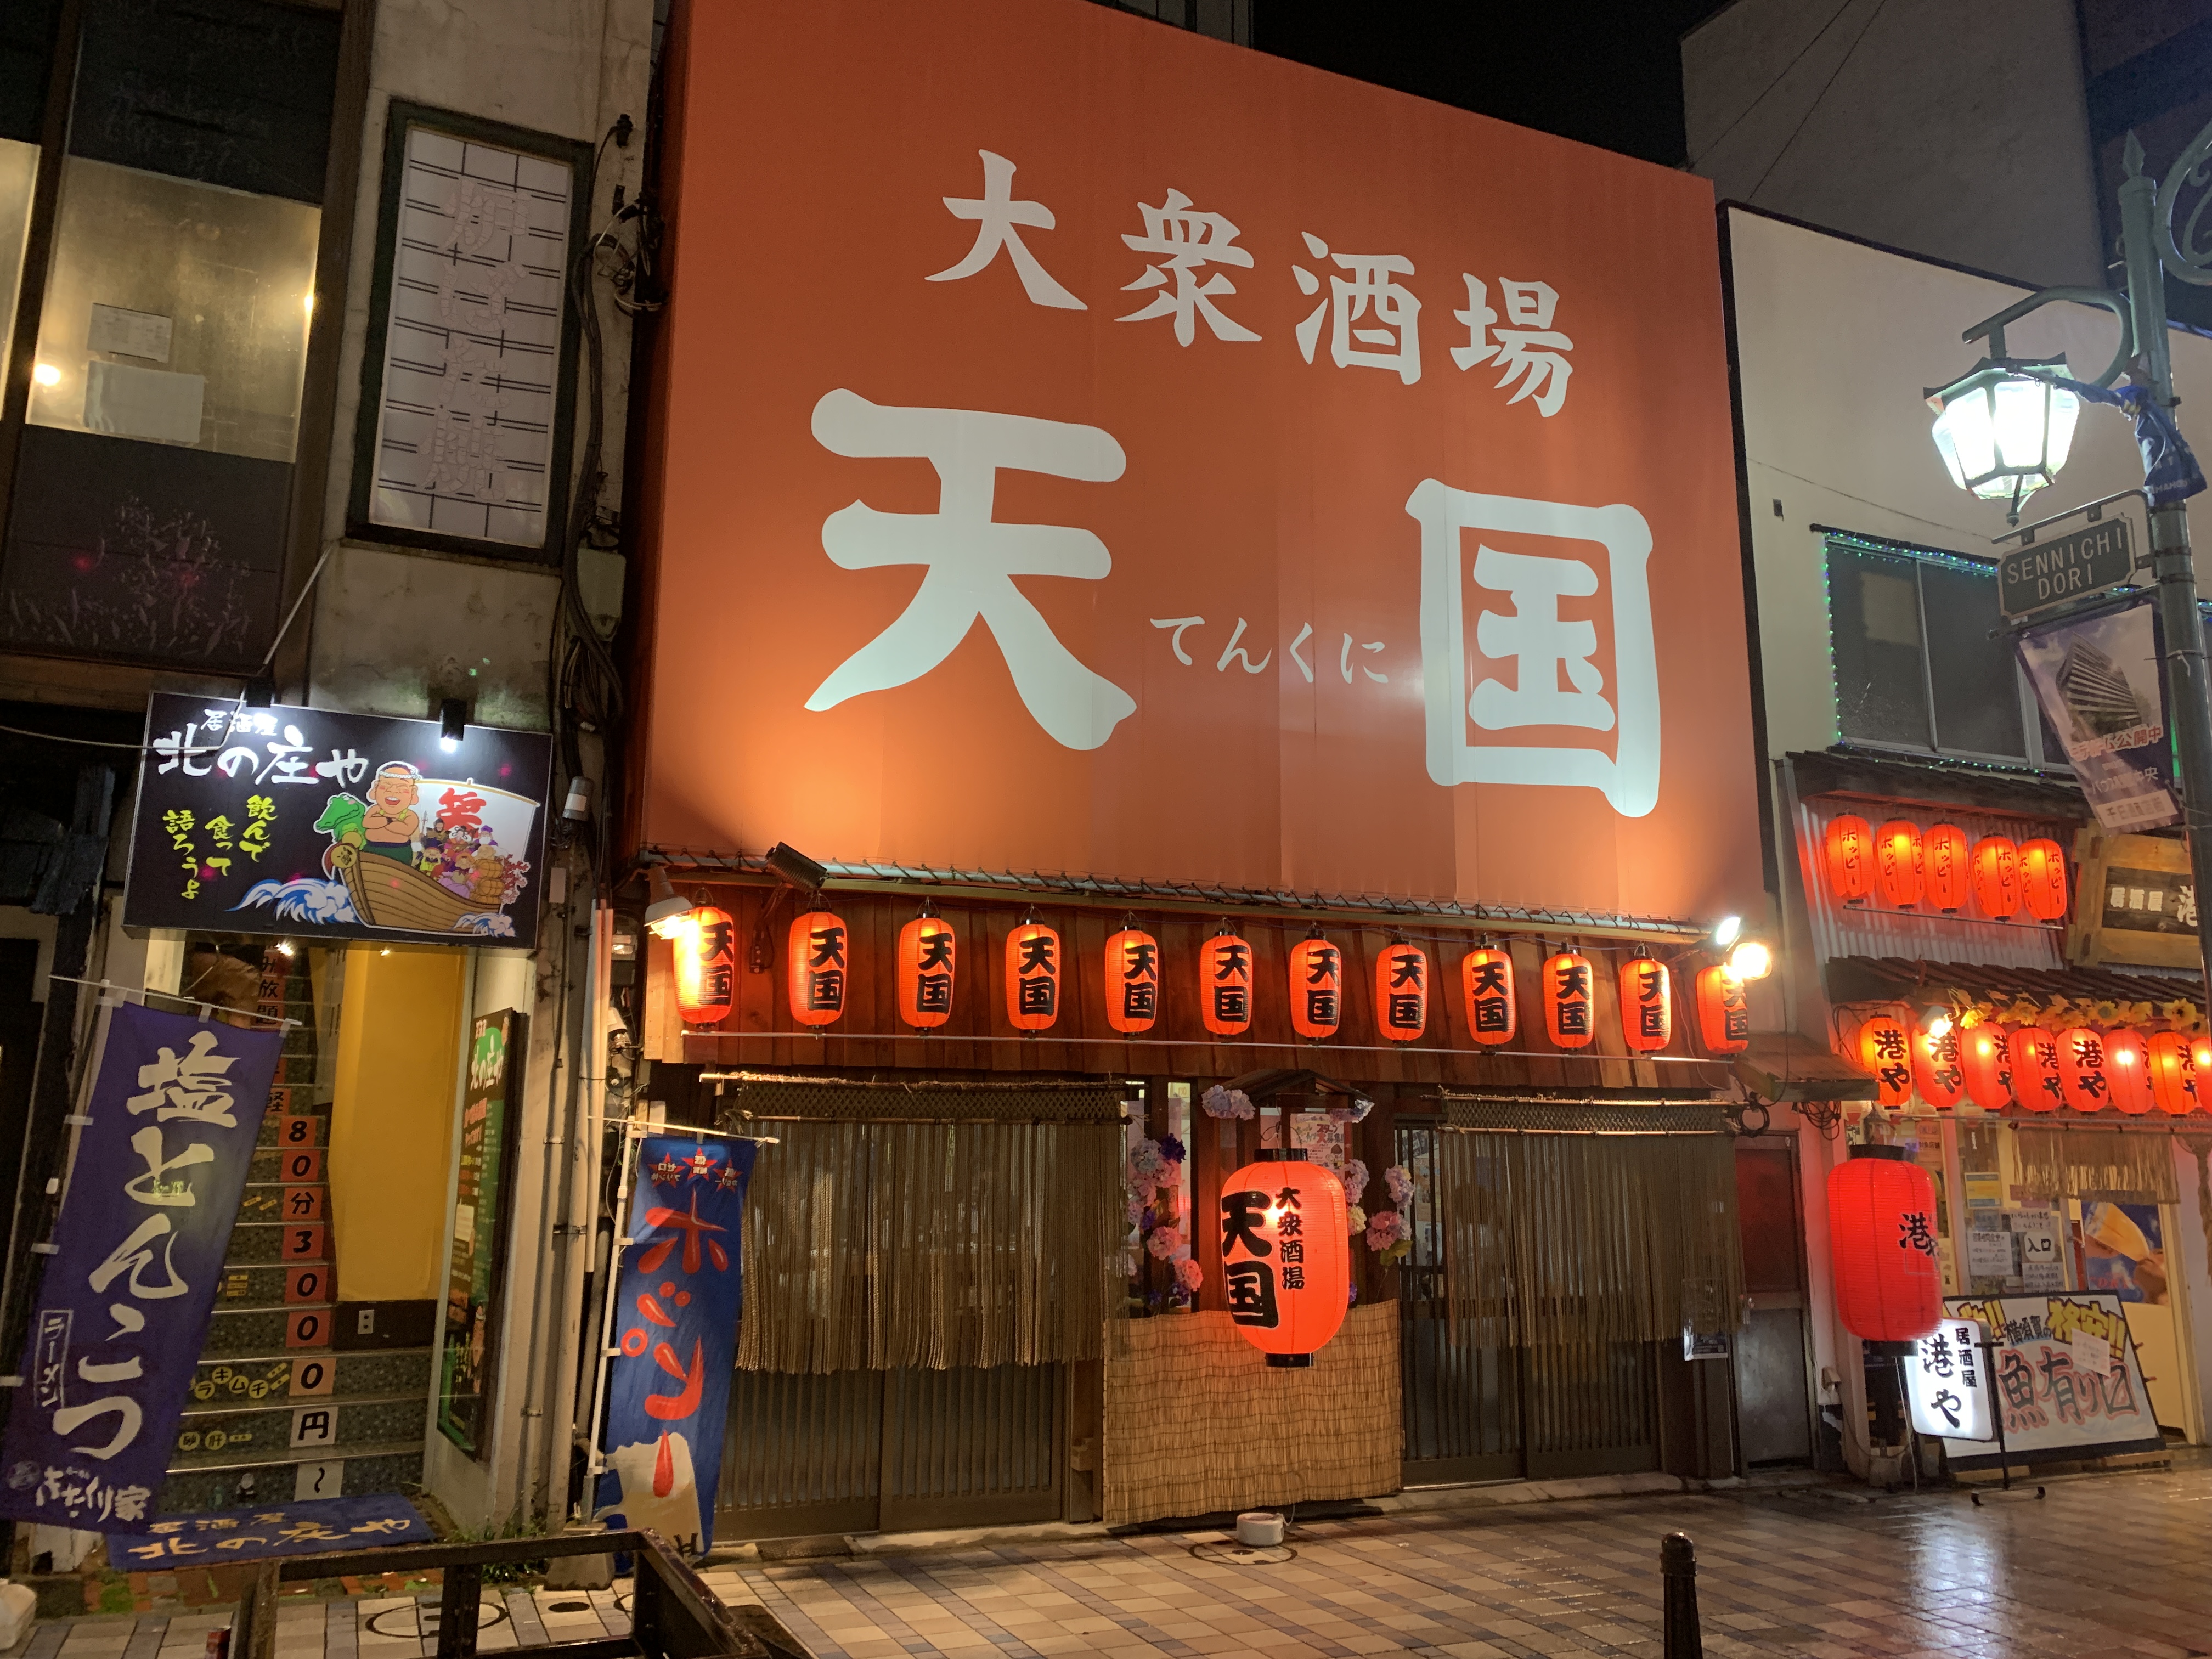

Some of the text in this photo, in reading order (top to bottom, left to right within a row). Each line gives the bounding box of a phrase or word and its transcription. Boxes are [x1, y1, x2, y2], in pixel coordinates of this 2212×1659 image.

[924, 149, 1574, 417] 大衆酒場
[2007, 526, 2123, 585] SENNICHI
[2038, 563, 2093, 600] DORI
[1150, 616, 1389, 685] てんくに
[153, 723, 368, 788] 北の庄や
[200, 709, 278, 736] 居酒屋
[162, 810, 200, 899] 語ろうよ
[205, 814, 234, 877] 食って
[240, 794, 278, 862] 飲んで
[1842, 828, 1860, 885] ホッピー
[1881, 837, 1895, 892] ホッピー
[1935, 837, 1951, 894] ホッピー
[1998, 849, 2014, 902] ホッピー
[2048, 851, 2062, 905] ホッピー
[2110, 887, 2163, 912] 居酒屋
[256, 956, 279, 1025] み放題
[701, 921, 733, 1006] 天国
[809, 927, 845, 1012] 天国
[917, 932, 953, 1014] 天国
[1018, 936, 1056, 1015] 天国
[1124, 943, 1156, 1019] 天国
[1214, 945, 1249, 1023] 天国
[1307, 949, 1339, 1026] 天国
[1389, 953, 1427, 1030] 天国
[1472, 961, 1508, 1032] 天国
[1556, 966, 1589, 1036] 天国
[1639, 970, 1670, 1038] 天国
[1874, 1029, 1910, 1093] 港や
[1928, 1032, 1962, 1094] 港や
[2072, 1040, 2107, 1099] 港や
[53, 1030, 241, 1460] 塩とんこつ
[1221, 1191, 1280, 1328] 天国
[1276, 1187, 1305, 1290] 大衆酒場
[2028, 1238, 2051, 1252] 入口
[37, 1317, 65, 1407] ラーメン
[1955, 1328, 1977, 1388] 居酒屋
[2004, 1314, 2052, 1344] 横須賀の
[193, 1368, 266, 1397] ラキムチ
[1921, 1333, 1962, 1429] 港や
[128, 1518, 411, 1560] 北の庄や
